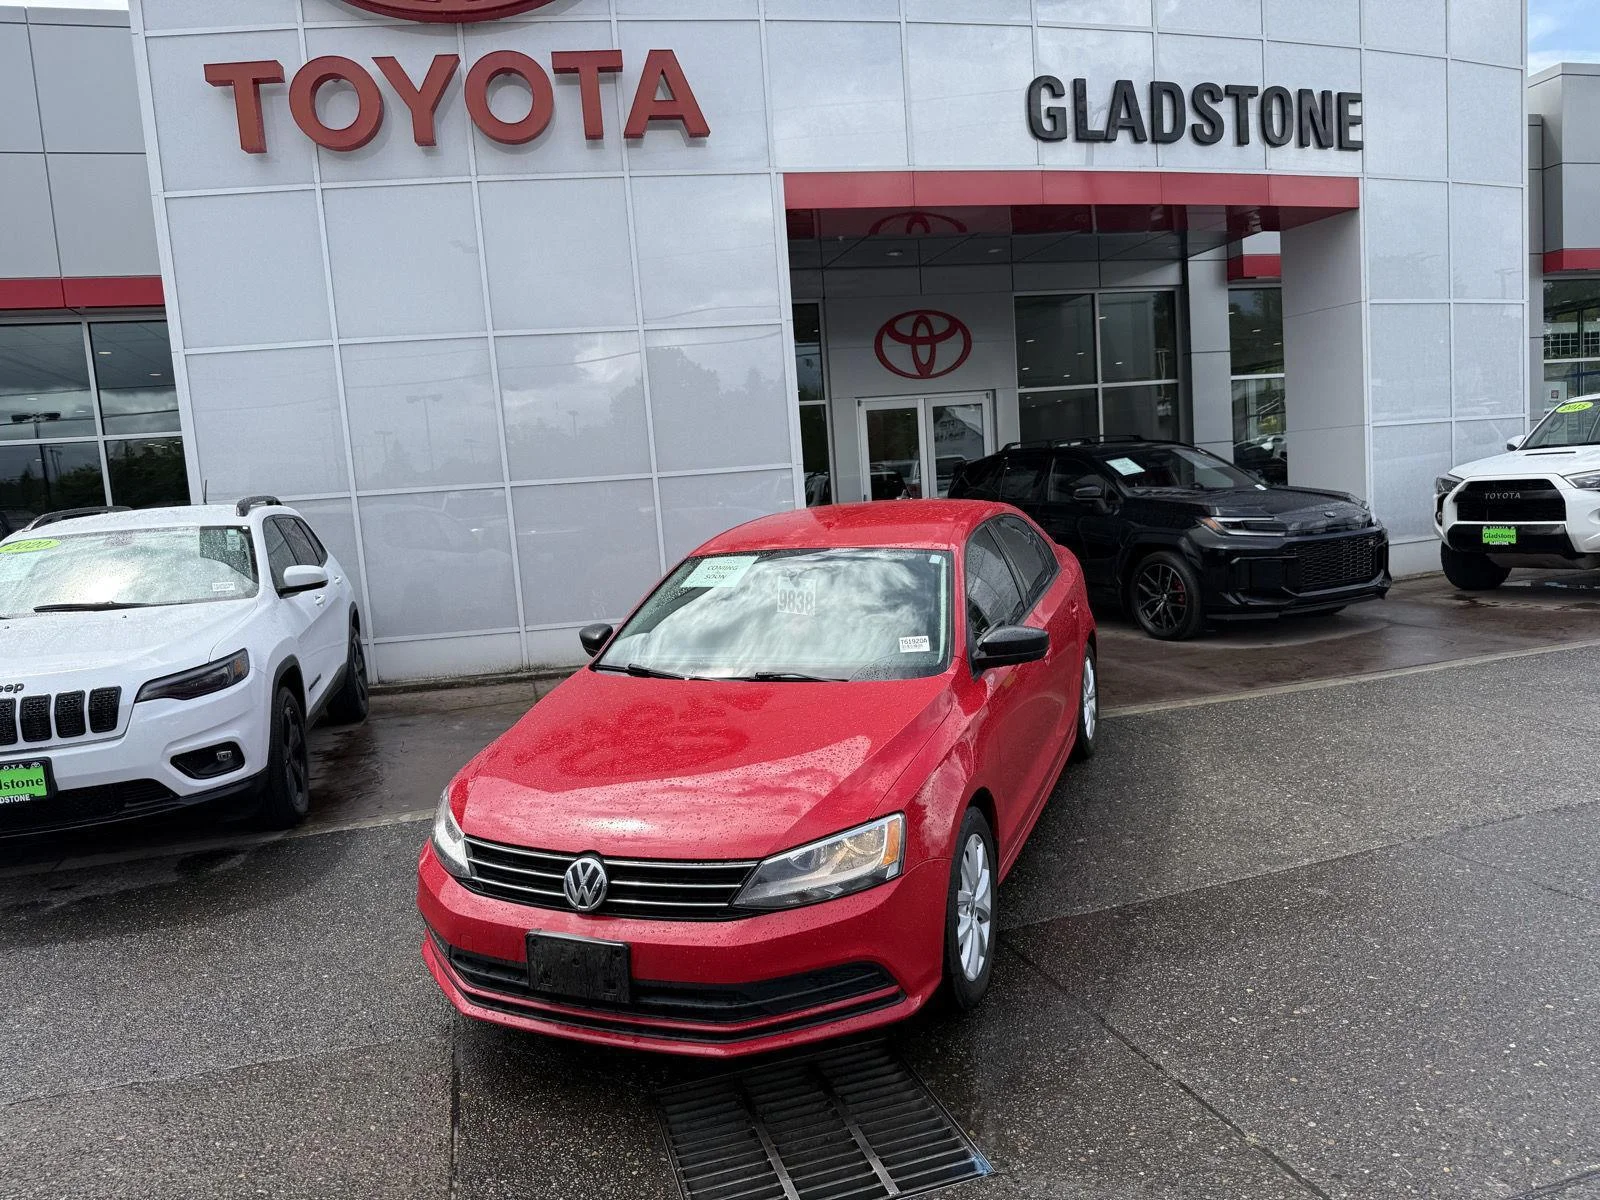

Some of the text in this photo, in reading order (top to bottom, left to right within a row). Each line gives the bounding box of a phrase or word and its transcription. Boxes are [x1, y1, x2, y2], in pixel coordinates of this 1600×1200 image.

[203, 49, 711, 154] TOYOTA
[1027, 75, 1364, 151] GLADSTONE
[1484, 492, 1521, 500] TOYOTA
[778, 588, 814, 613] 9838
[0, 683, 25, 694] ep
[3, 763, 25, 771] OTA
[0, 777, 44, 791] stone
[0, 793, 31, 804] DSTONE
